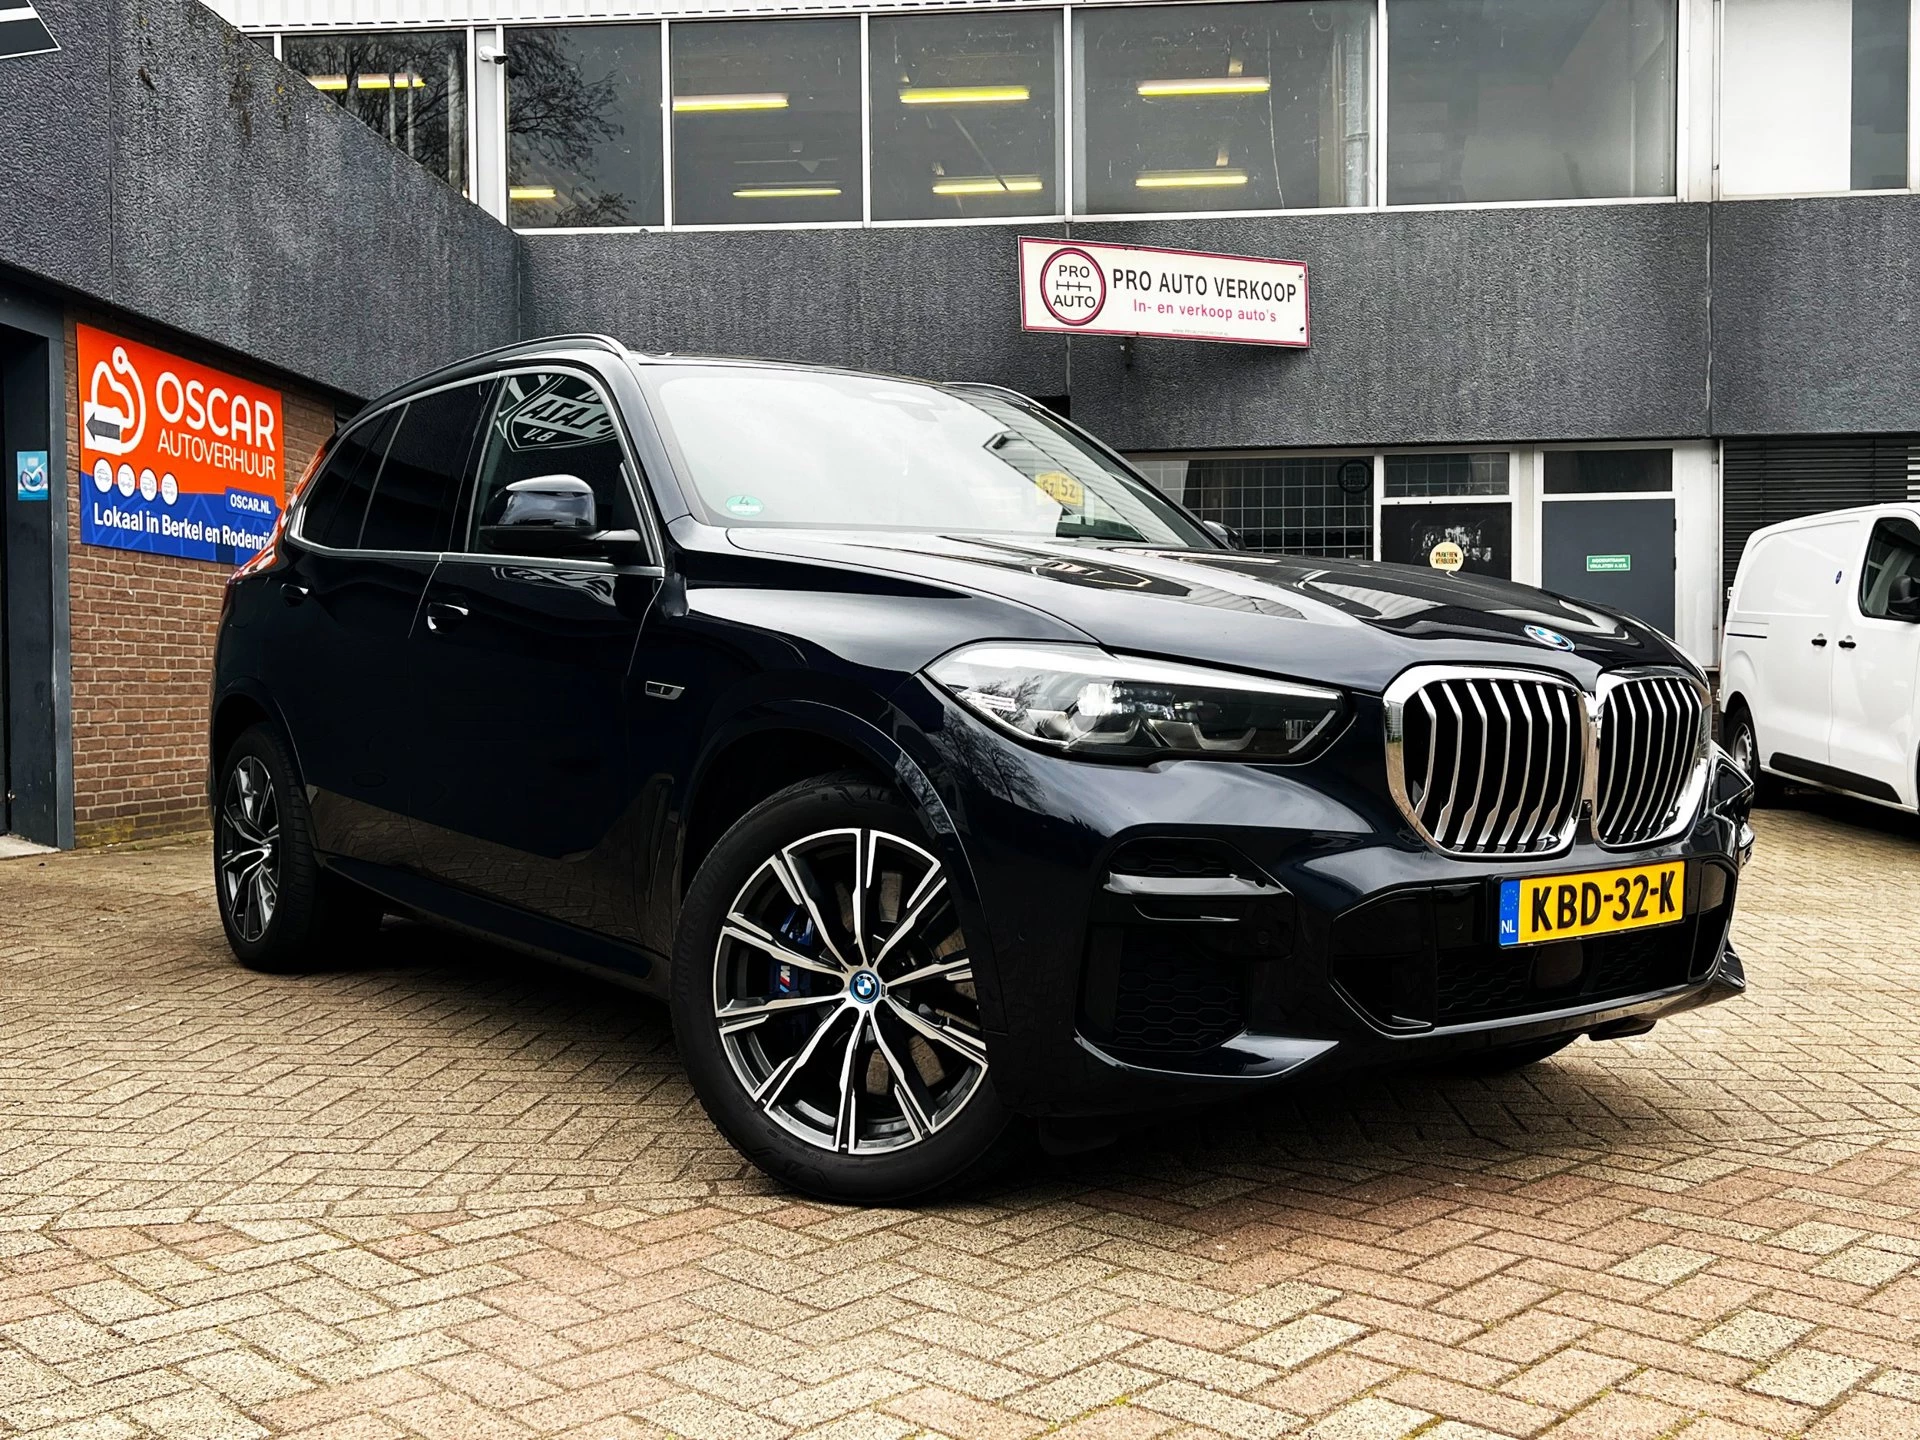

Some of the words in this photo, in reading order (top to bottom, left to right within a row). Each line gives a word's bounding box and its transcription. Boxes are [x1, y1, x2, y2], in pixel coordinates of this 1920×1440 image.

[1059, 265, 1090, 278] PRO
[1113, 269, 1151, 292] PRO
[1159, 273, 1207, 296] AUTO
[1214, 277, 1297, 302] VERKOOP
[1053, 294, 1096, 308] AUTO
[1133, 299, 1152, 312] In-
[1157, 303, 1174, 314] en
[1179, 302, 1233, 321] verkoop
[1237, 308, 1277, 322] auto's
[156, 371, 276, 451] OSCAR
[157, 429, 276, 480] AUTOVERHUUR
[230, 494, 272, 515] OSCAR.NL
[739, 496, 750, 506] 4
[94, 502, 144, 532] Lokaal
[146, 514, 159, 535] in
[162, 515, 202, 540] Berkel
[205, 526, 220, 543] en
[222, 525, 270, 550] Rodenri
[1532, 870, 1676, 932] KBD-32-K
[1501, 919, 1516, 933] NL
